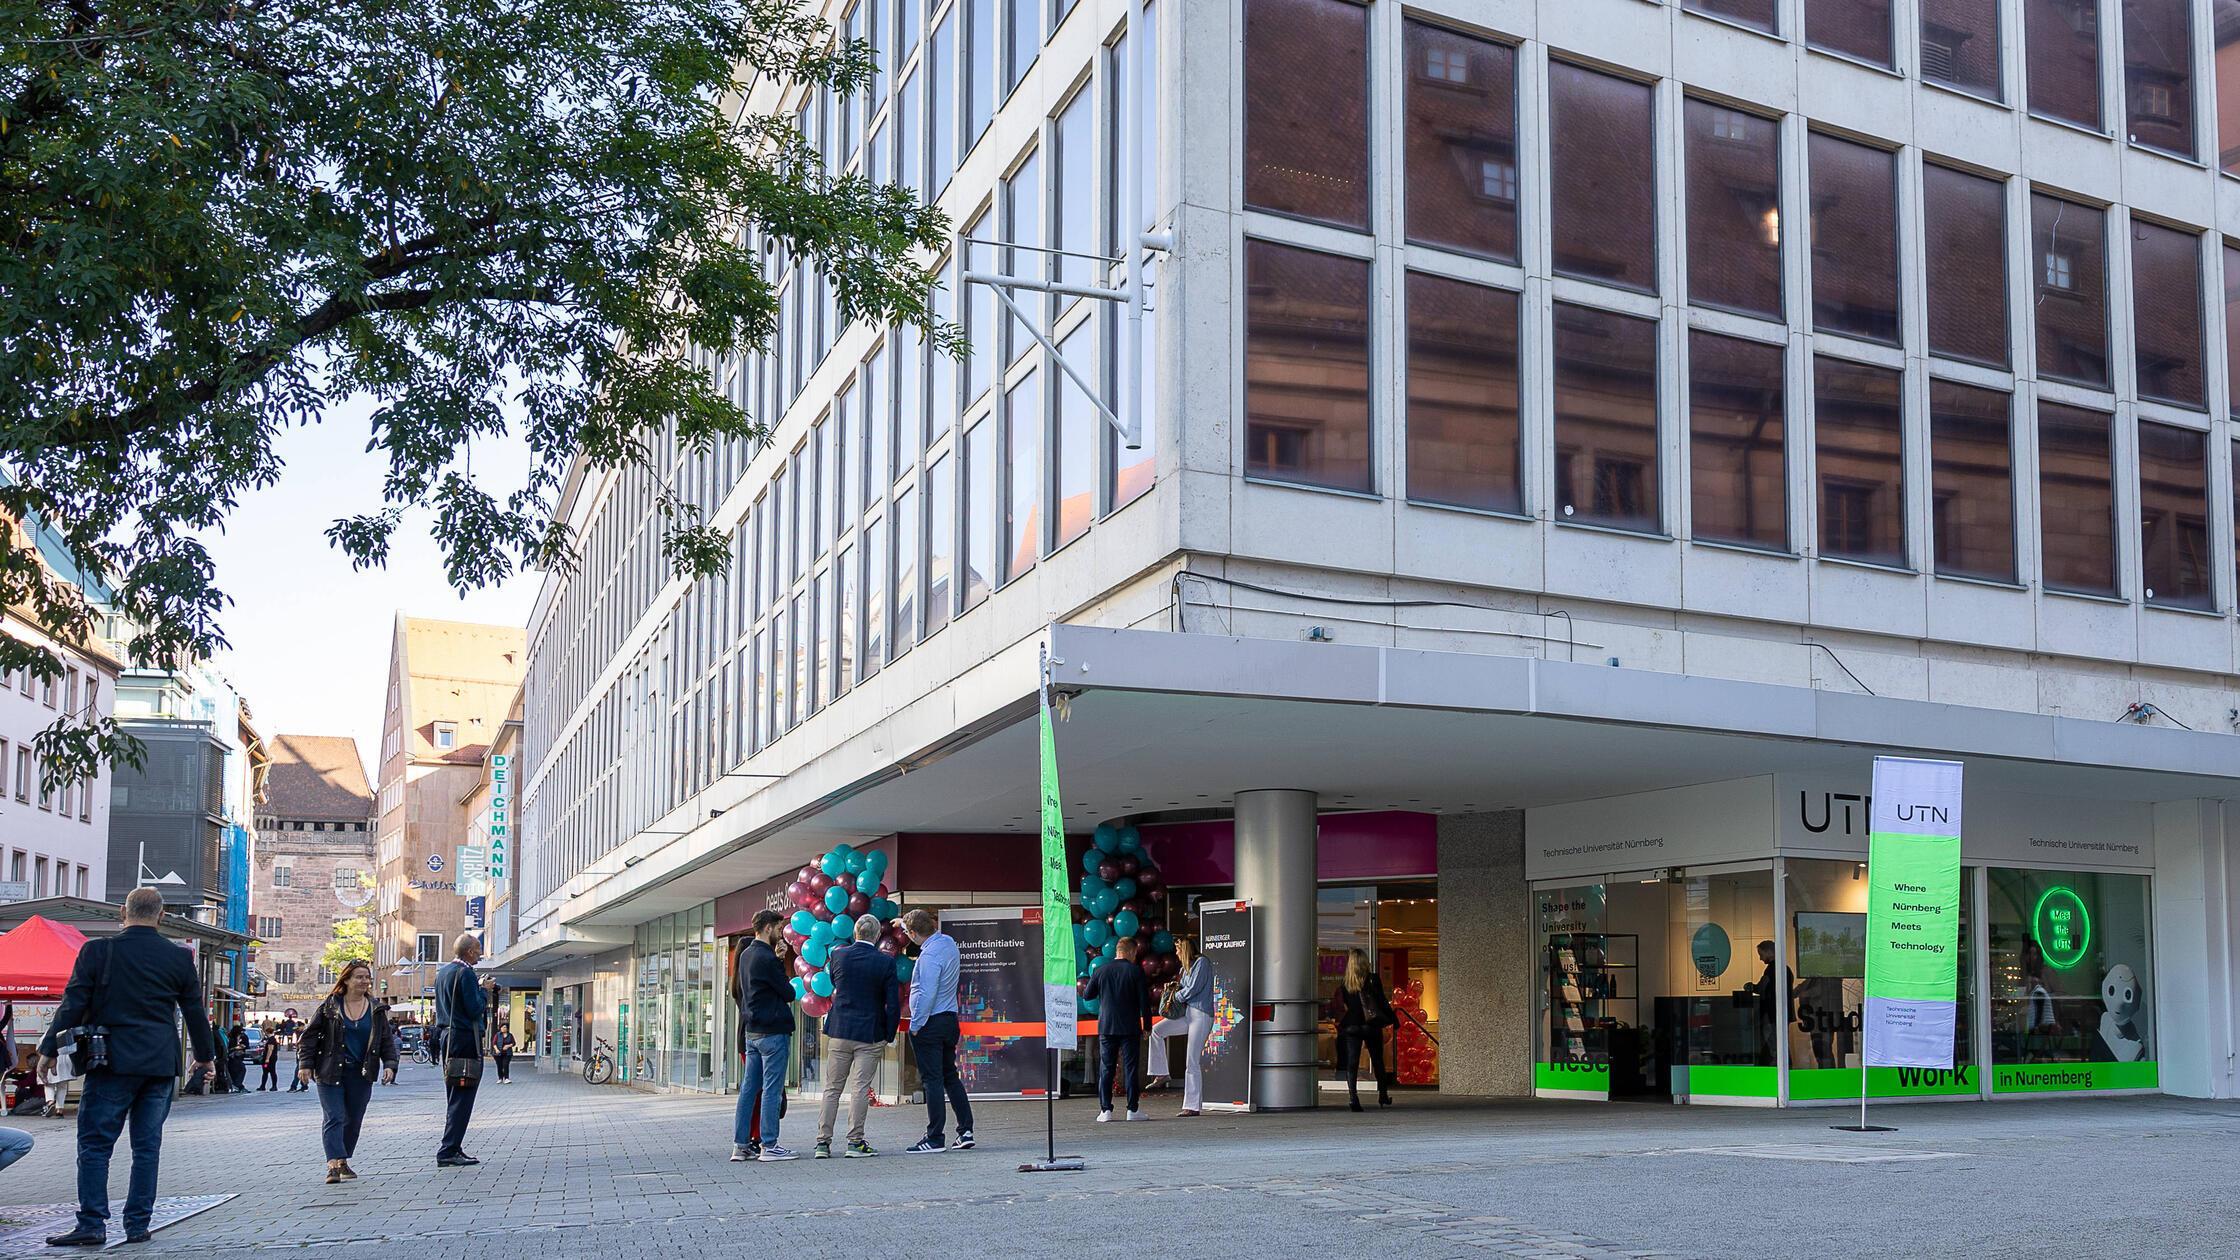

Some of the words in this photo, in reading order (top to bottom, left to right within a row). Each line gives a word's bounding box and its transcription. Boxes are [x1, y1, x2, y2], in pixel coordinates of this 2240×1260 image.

[491, 755, 506, 878] DEICHMANN
[1897, 803, 1948, 824] UTN
[1543, 847, 1582, 858] Technische
[1583, 841, 1624, 854] Universität
[1625, 836, 1664, 849] Nürnberg
[2029, 838, 2068, 849] Technische
[2068, 841, 2106, 852] Universität
[2106, 842, 2139, 855] Nürnberg
[456, 882, 485, 895] FOTO
[1894, 883, 1927, 893] Where
[1542, 901, 1569, 914] Shape
[1572, 899, 1586, 911] the
[1892, 902, 1941, 914] Nürnberg
[1542, 921, 1587, 933] University
[1891, 922, 1922, 931] Meets
[1205, 941, 1223, 950] POP-UP
[1223, 940, 1246, 949] KAUFHOF
[1890, 941, 1945, 953] Technology
[960, 950, 997, 960] nenstadt
[1563, 962, 1577, 972] us!
[1798, 1003, 1863, 1033] Stud
[1898, 1065, 1969, 1088] Work
[2000, 1071, 2012, 1087] in
[2015, 1069, 2093, 1088] Nuremberg
